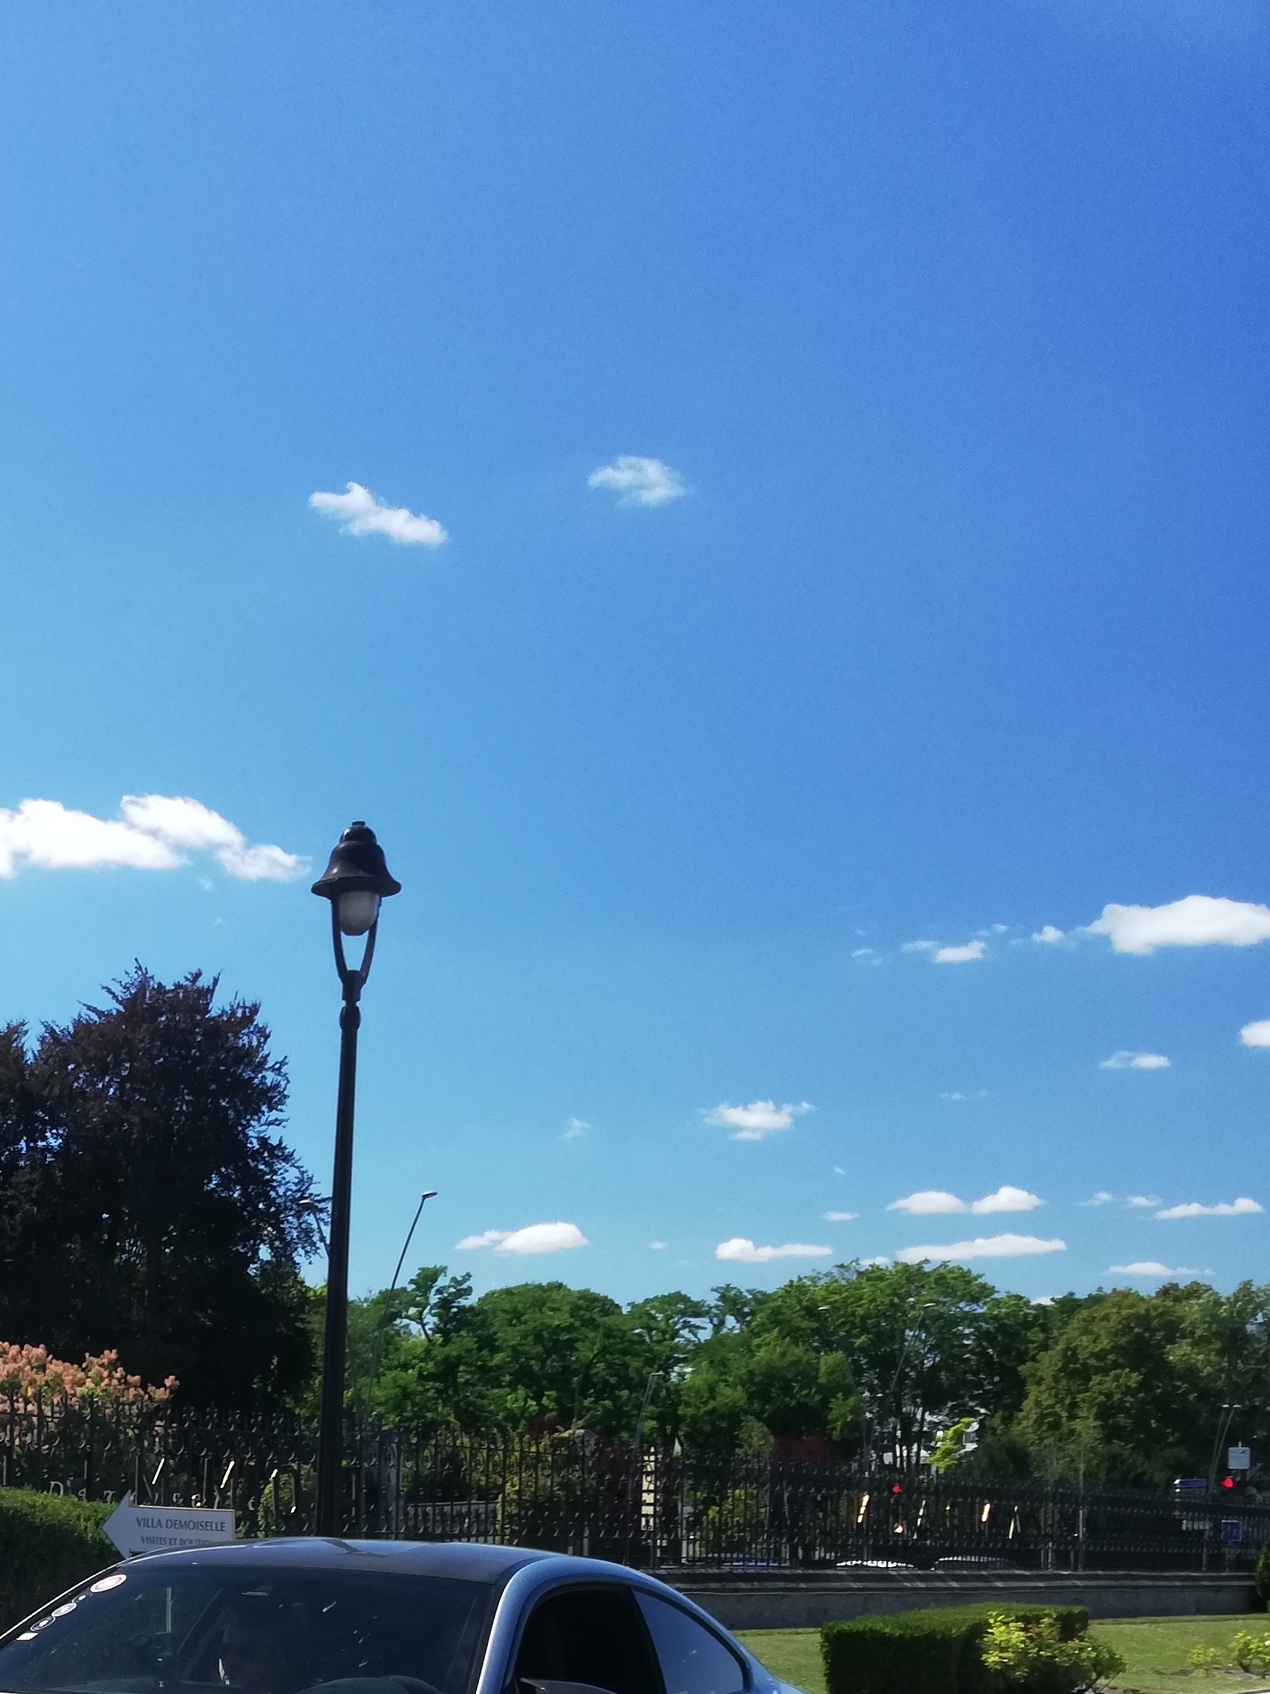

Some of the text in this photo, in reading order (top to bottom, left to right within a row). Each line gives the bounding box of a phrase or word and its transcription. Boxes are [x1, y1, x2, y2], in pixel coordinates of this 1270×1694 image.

[136, 1517, 226, 1532] VILLA DEMOISELLE
[140, 1535, 167, 1546] VISITES
[168, 1537, 178, 1546] ET
